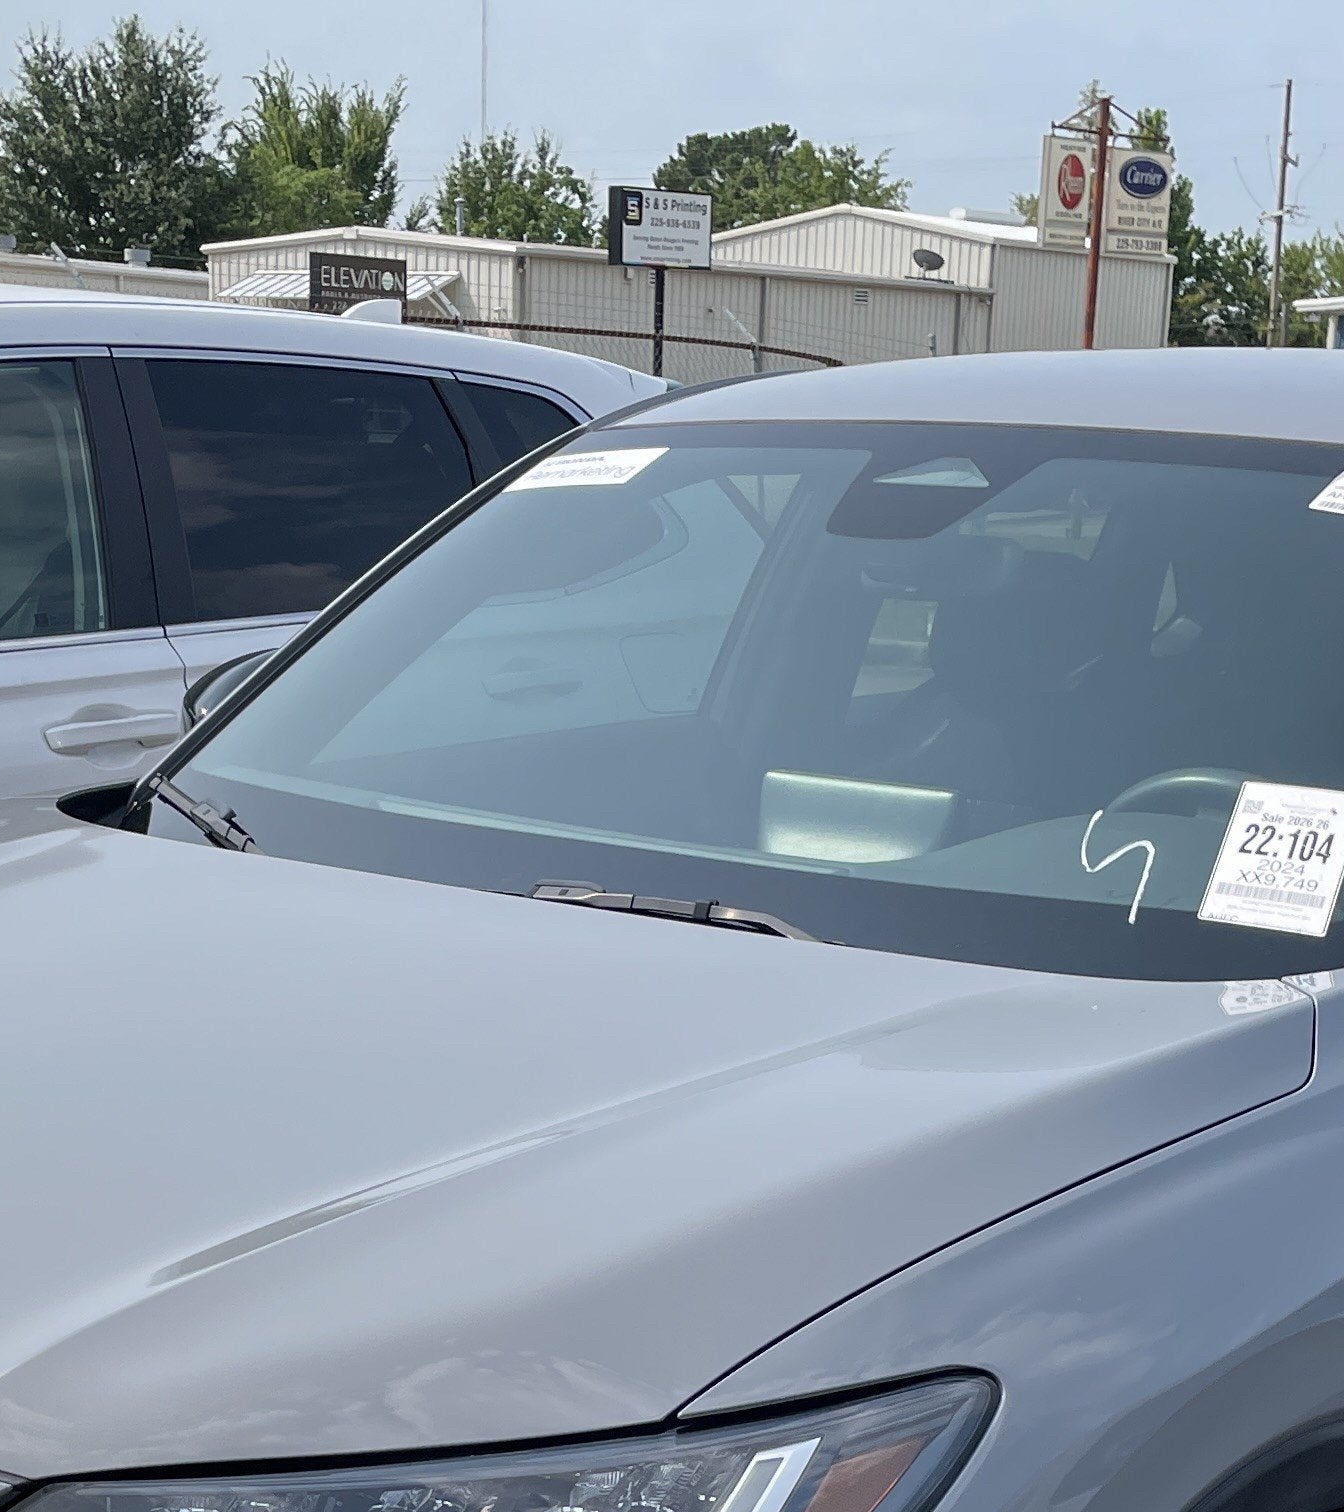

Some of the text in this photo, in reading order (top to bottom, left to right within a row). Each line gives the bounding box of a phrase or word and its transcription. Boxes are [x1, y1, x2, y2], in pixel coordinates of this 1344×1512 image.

[1126, 165, 1164, 186] Carrier
[644, 197, 708, 216] S & S Printing
[320, 265, 405, 292] ELEVATION
[1261, 812, 1285, 825] Sale
[1287, 814, 1313, 828] 2026
[1238, 823, 1335, 865] 22:104
[1256, 858, 1306, 876] 2024
[1235, 869, 1319, 893] XX9,749
